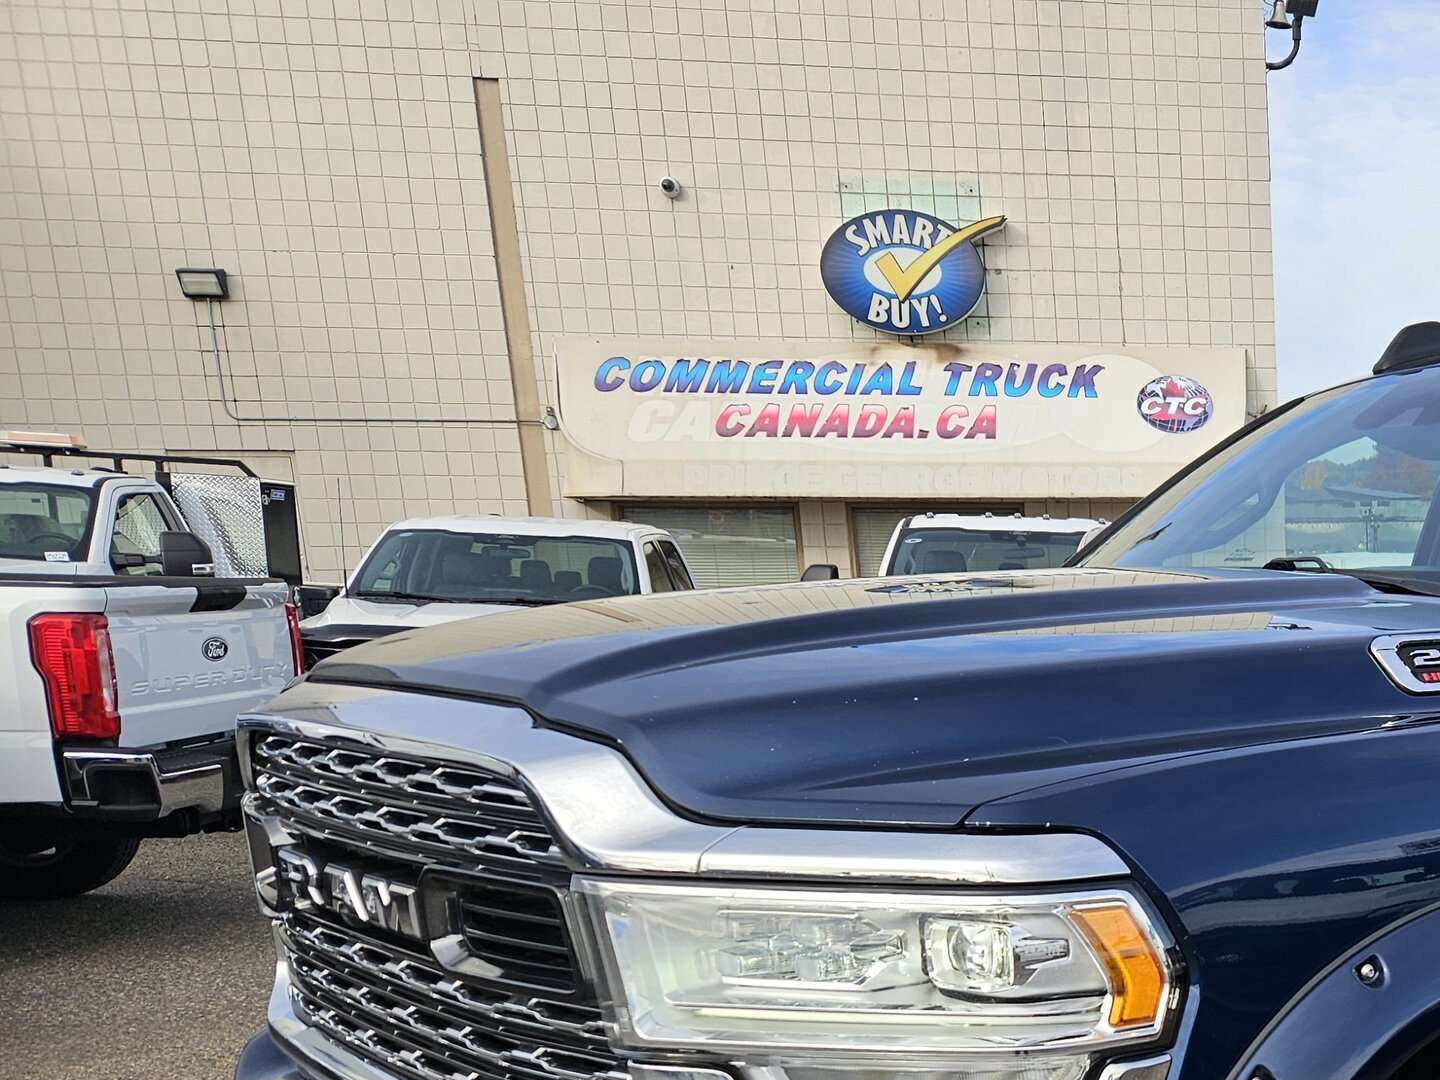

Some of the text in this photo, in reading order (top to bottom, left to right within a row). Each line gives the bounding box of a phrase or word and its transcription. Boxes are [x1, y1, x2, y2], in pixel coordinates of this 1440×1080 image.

[867, 292, 948, 328] BUY!
[593, 356, 1106, 398] COMMERCIAL TRUCK
[715, 402, 998, 440] CANADA.CA
[1140, 396, 1208, 416] CTC
[131, 671, 227, 697] SUPER
[277, 849, 422, 940] RAM
